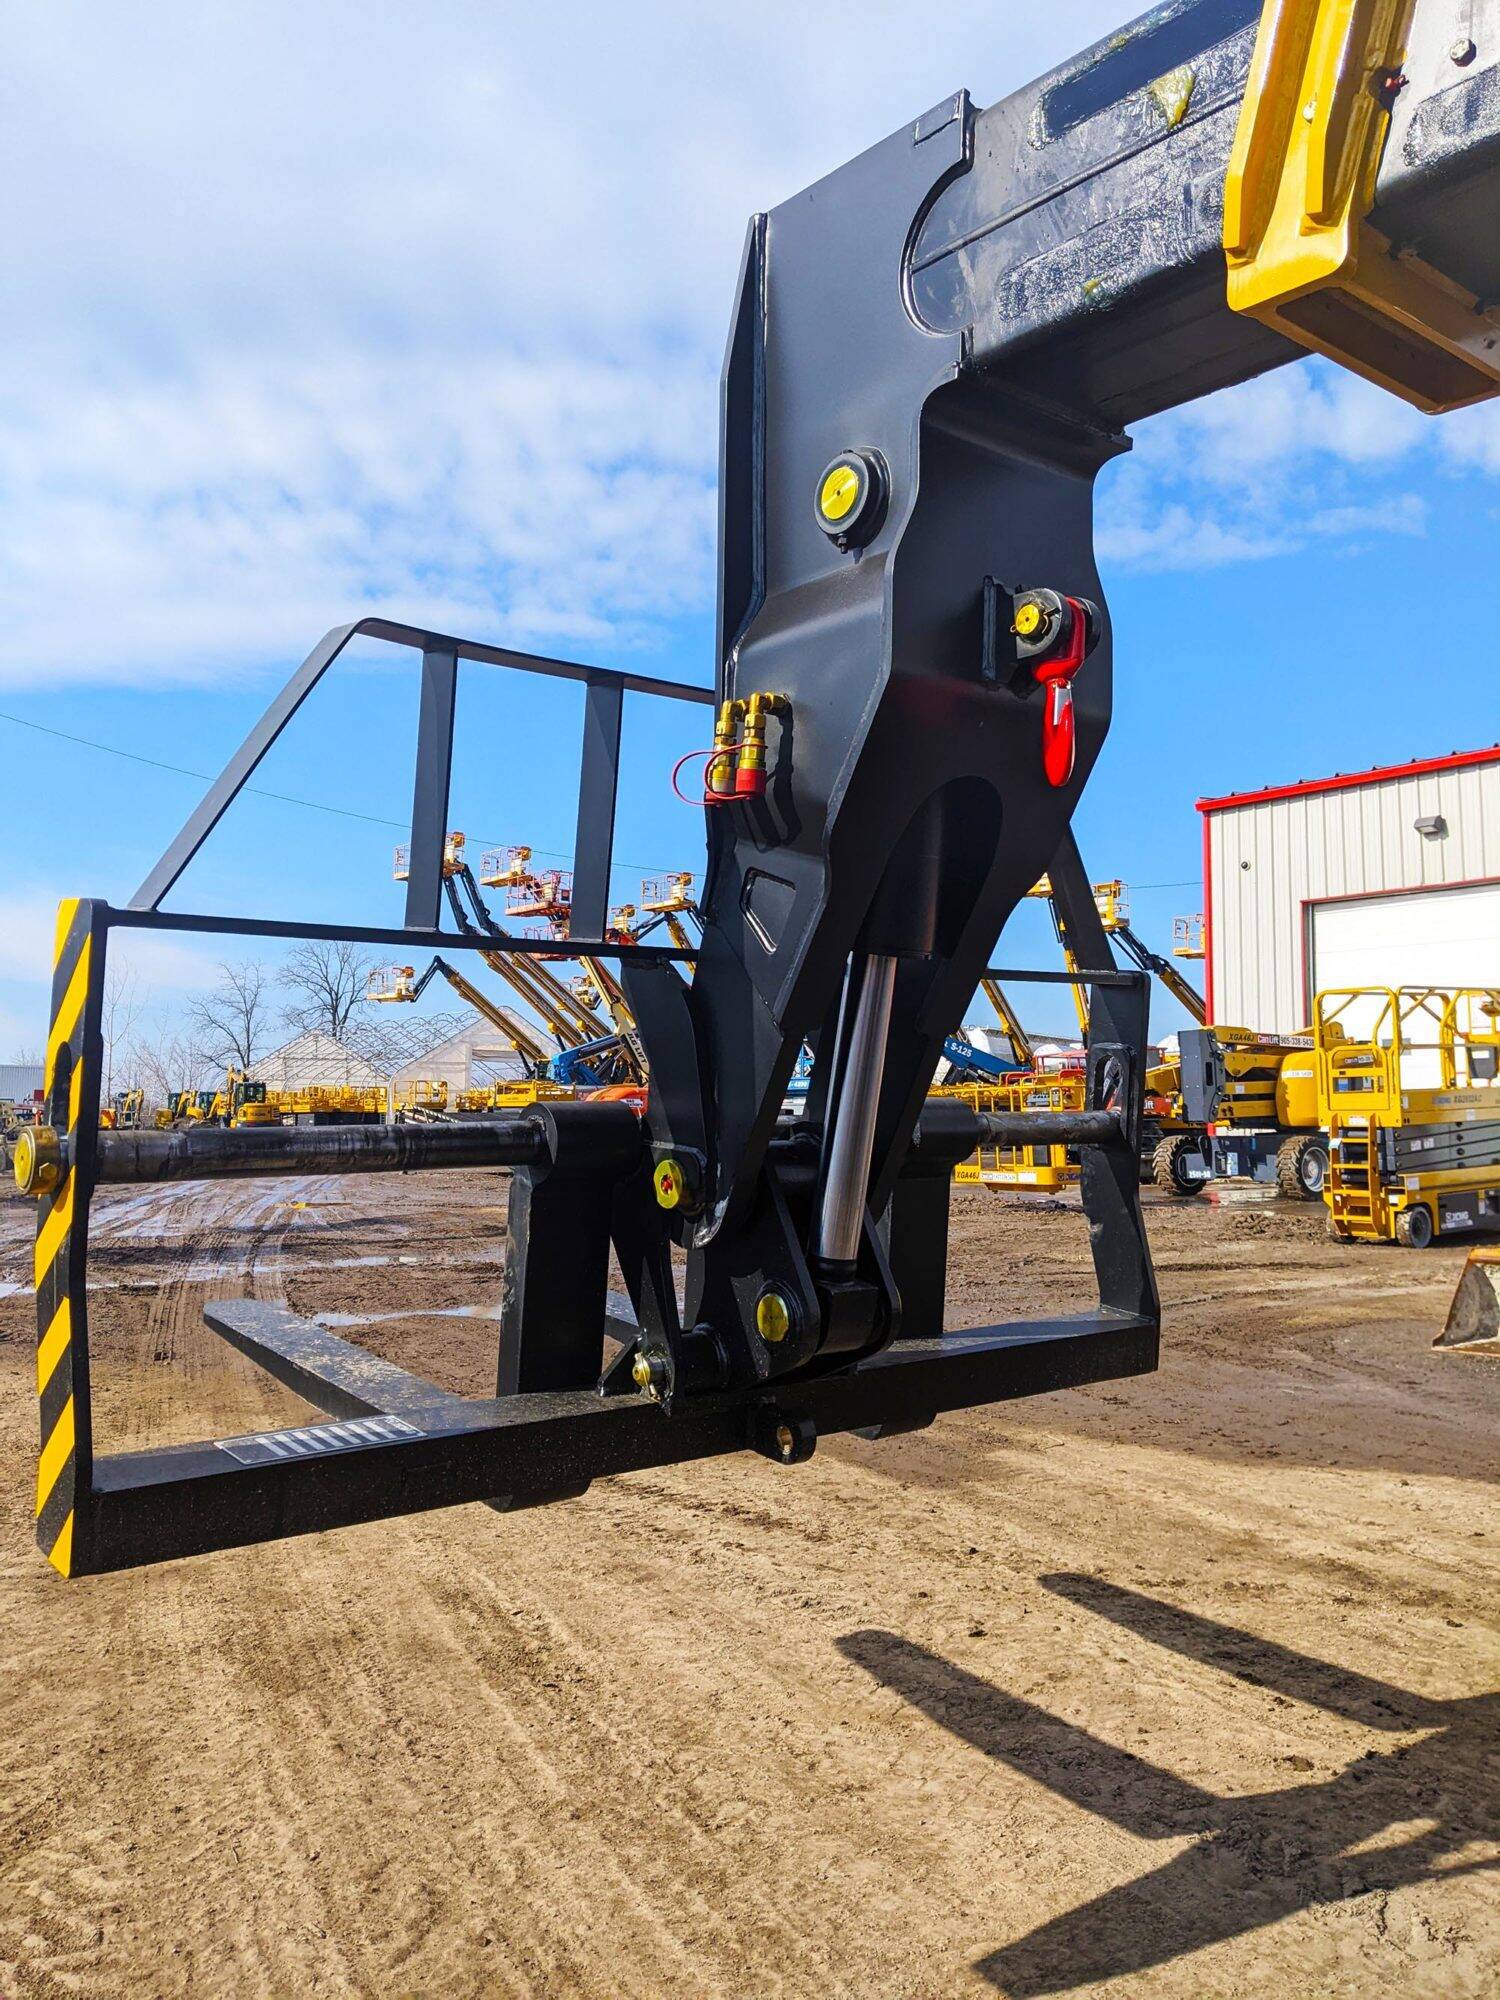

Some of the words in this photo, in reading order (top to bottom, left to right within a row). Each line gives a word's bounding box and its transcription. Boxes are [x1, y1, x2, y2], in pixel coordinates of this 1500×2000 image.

[1228, 1033, 1255, 1042] XGA46J
[950, 1042, 973, 1058] S-125
[956, 1171, 980, 1180] XGA46J
